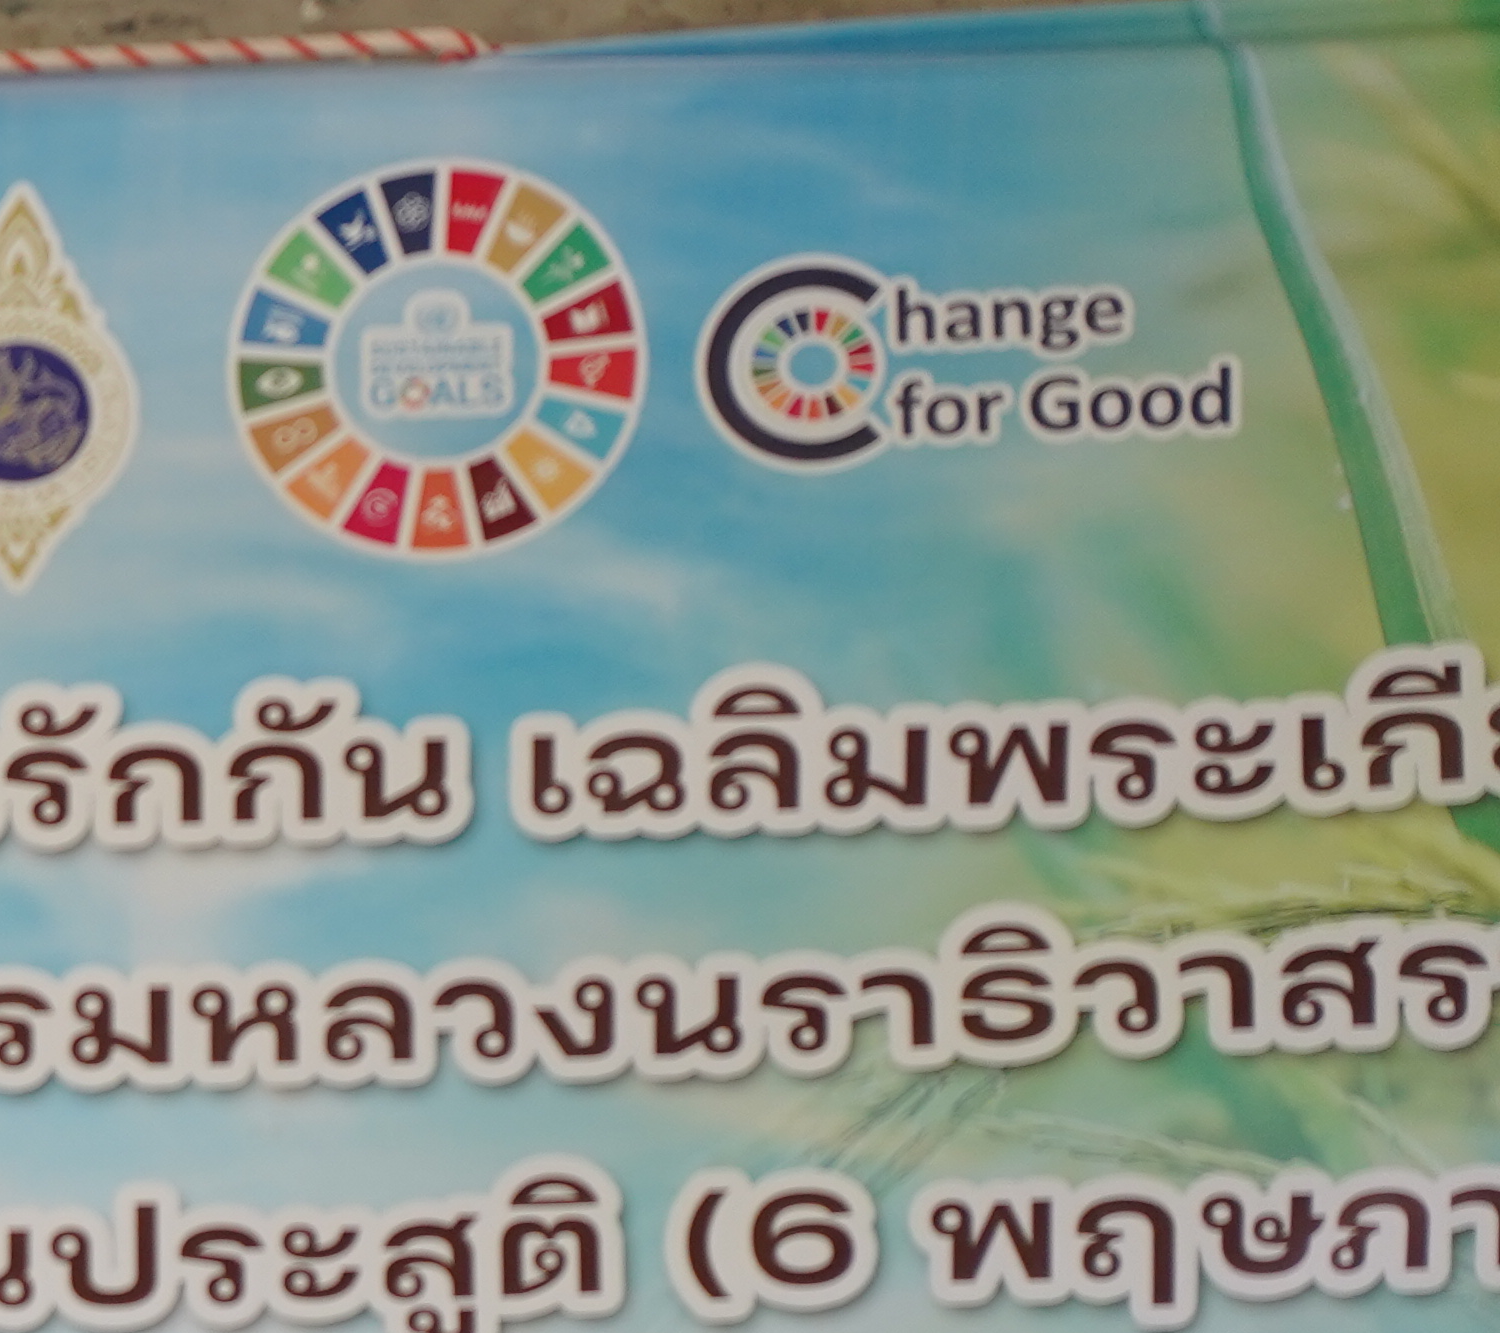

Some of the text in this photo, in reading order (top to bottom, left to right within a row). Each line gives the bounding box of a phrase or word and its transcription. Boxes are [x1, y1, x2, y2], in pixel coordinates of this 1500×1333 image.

[892, 361, 1234, 438] for Good
[530, 663, 1500, 817] เฉลิมพระเกี
[687, 1184, 855, 1299] (6
